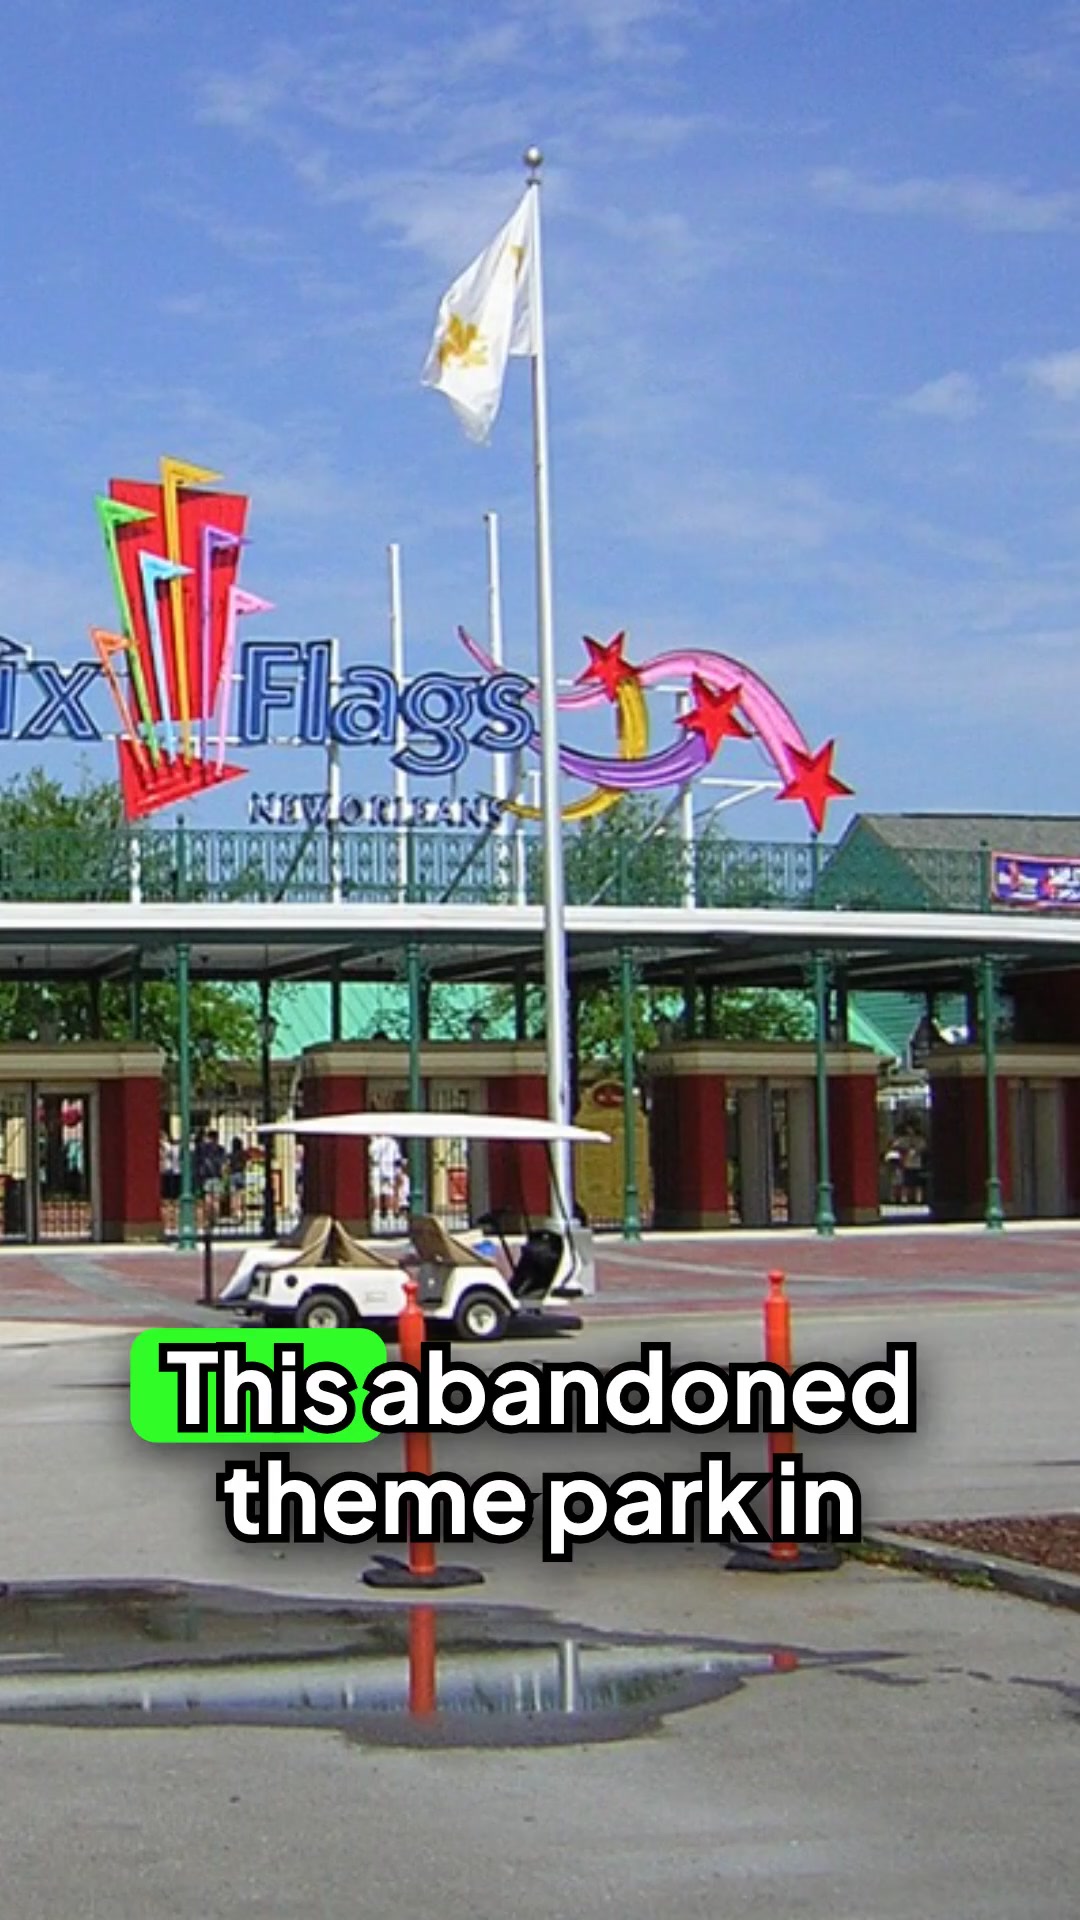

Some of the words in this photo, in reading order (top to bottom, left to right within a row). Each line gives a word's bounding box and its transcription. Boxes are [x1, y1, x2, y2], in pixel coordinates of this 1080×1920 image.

[240, 640, 537, 776] Flags
[248, 792, 332, 825] NEW
[339, 794, 505, 828] ORLEANS
